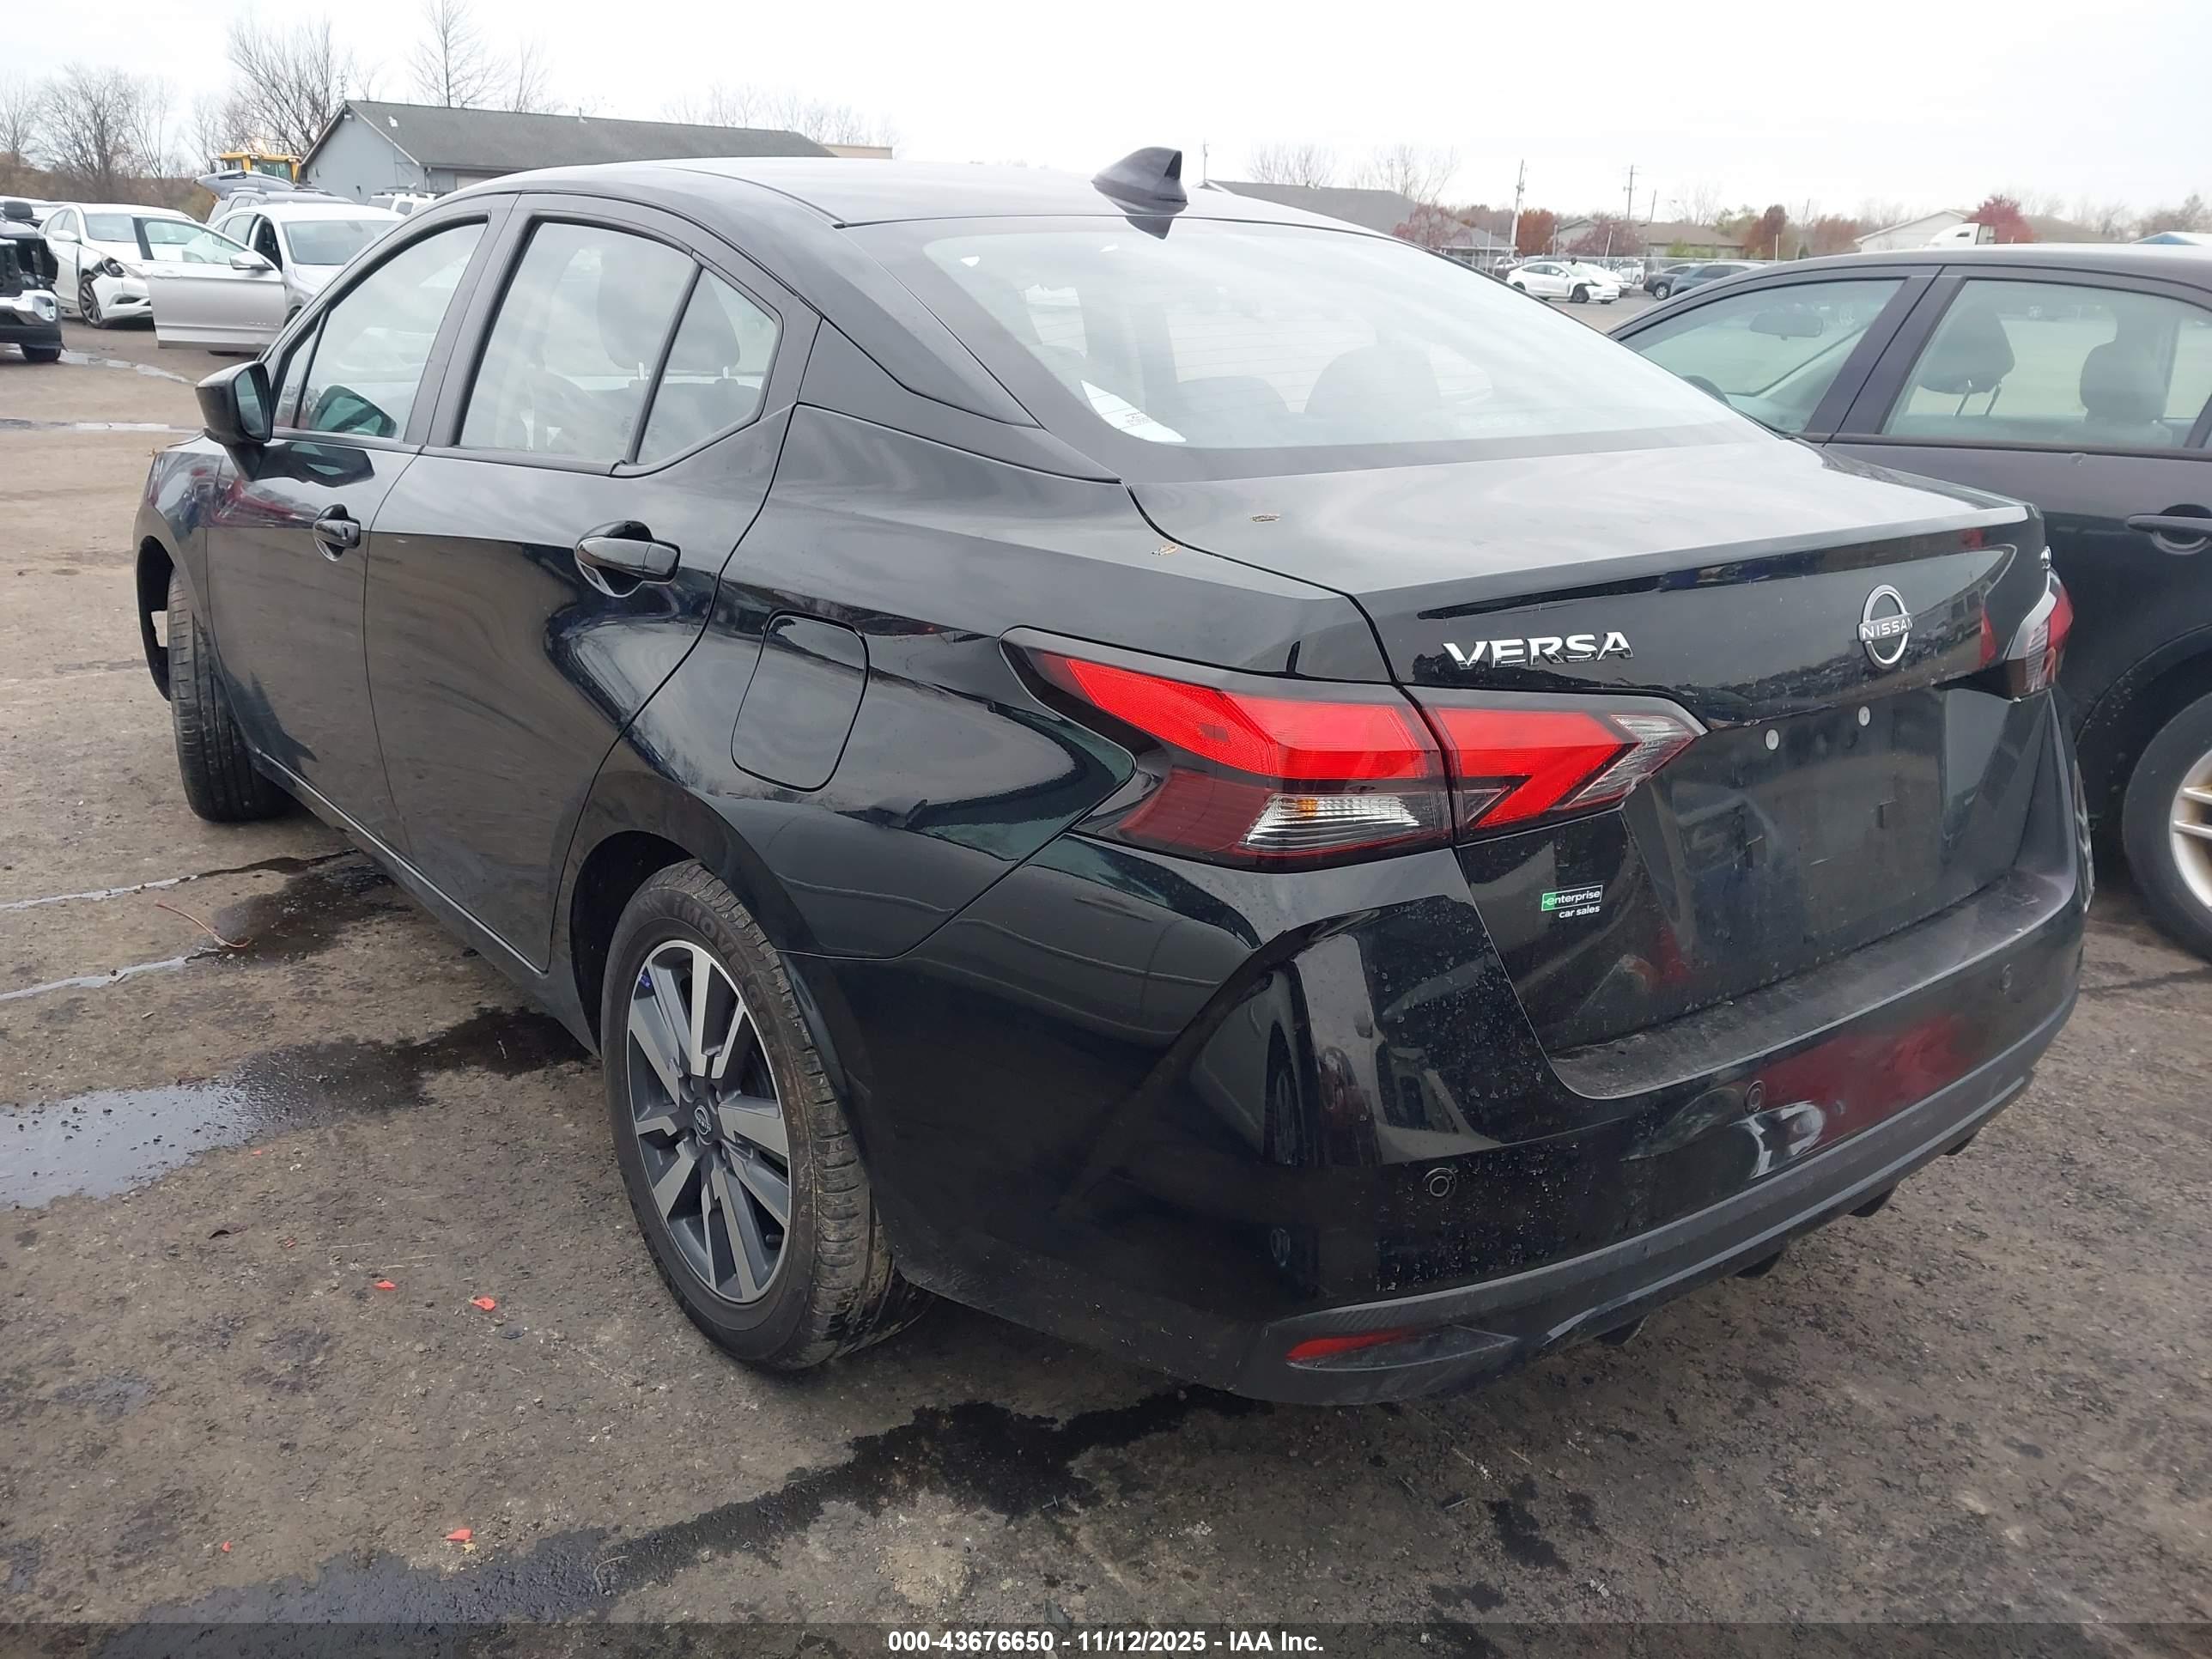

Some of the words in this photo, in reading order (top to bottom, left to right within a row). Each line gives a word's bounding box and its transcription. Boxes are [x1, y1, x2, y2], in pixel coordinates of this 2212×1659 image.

[1862, 617, 1913, 639] NISSAN
[1443, 631, 1634, 670] VERSA
[1545, 890, 1601, 905] enterprise
[1559, 909, 1575, 918] car
[1576, 905, 1601, 915] sales
